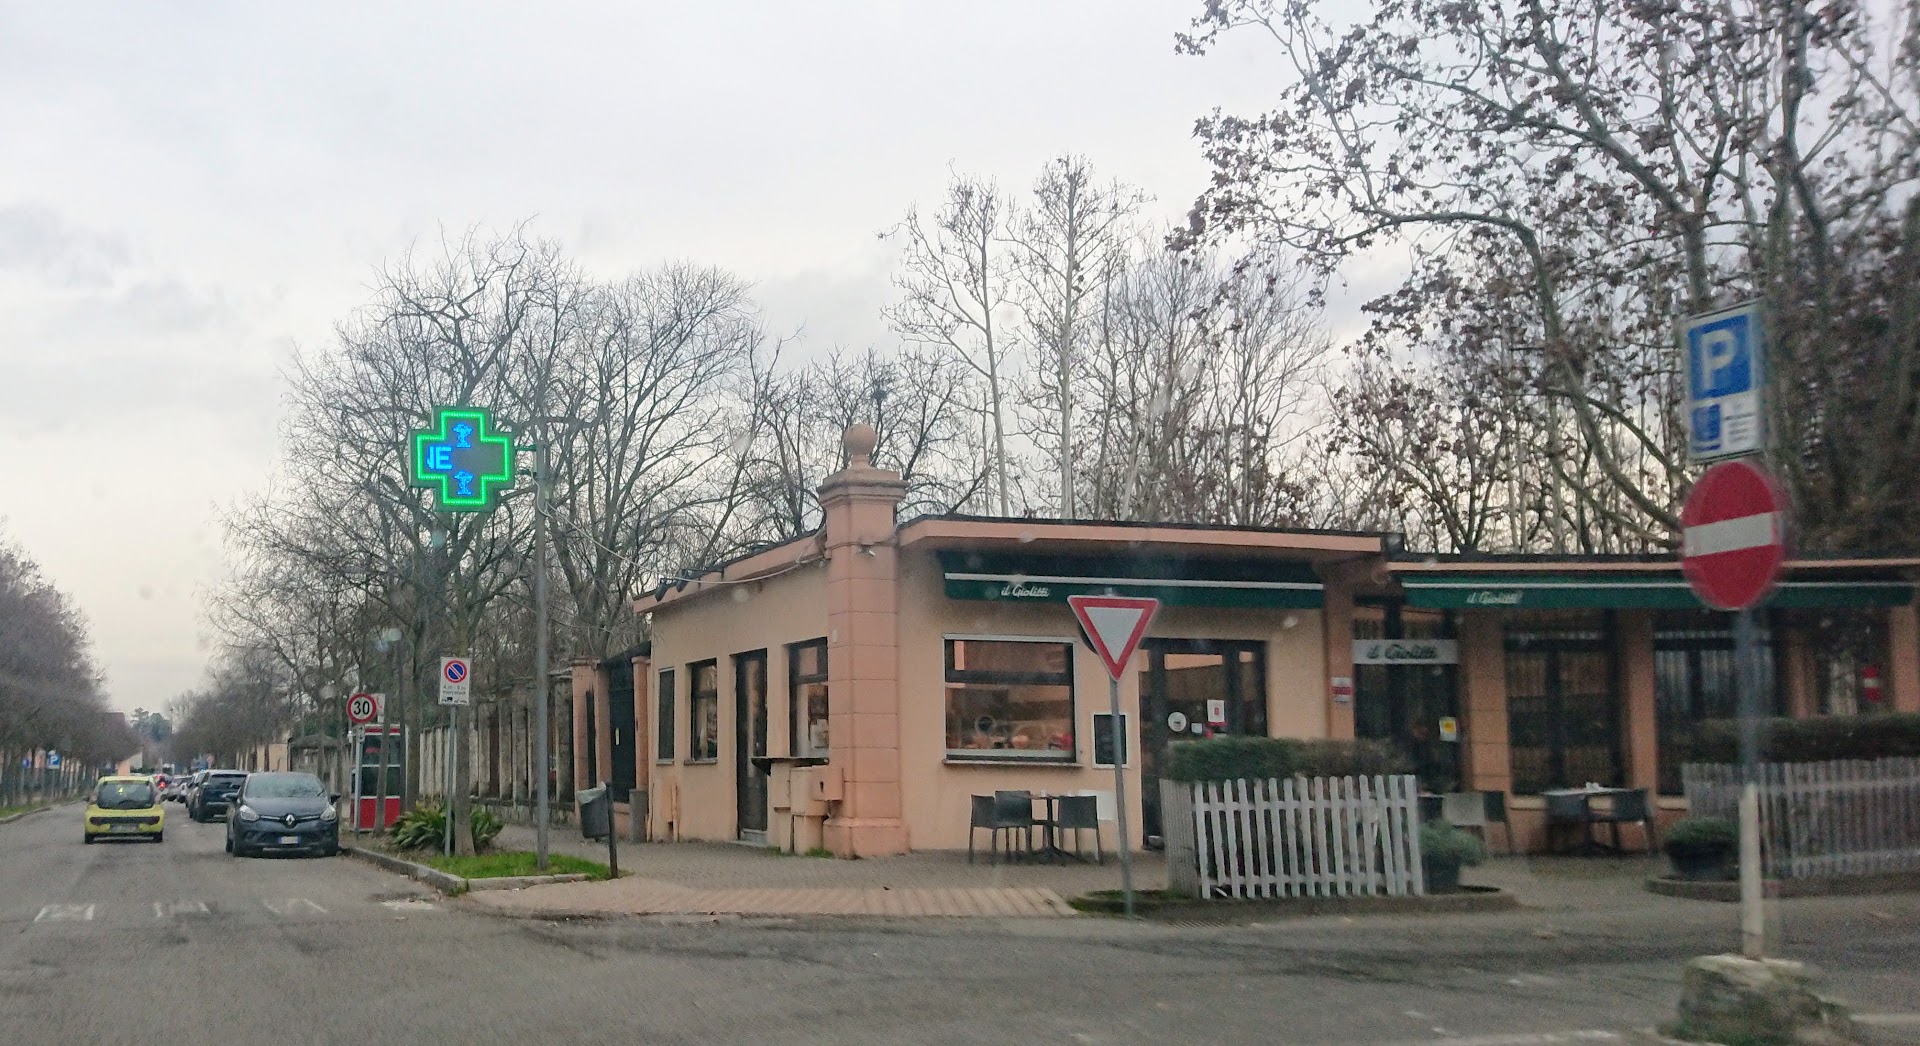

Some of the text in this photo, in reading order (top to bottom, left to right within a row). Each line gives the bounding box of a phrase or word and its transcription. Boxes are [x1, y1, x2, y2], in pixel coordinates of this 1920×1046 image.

[1701, 329, 1736, 390] P
[1001, 585, 1010, 596] il
[353, 700, 370, 715] 30
